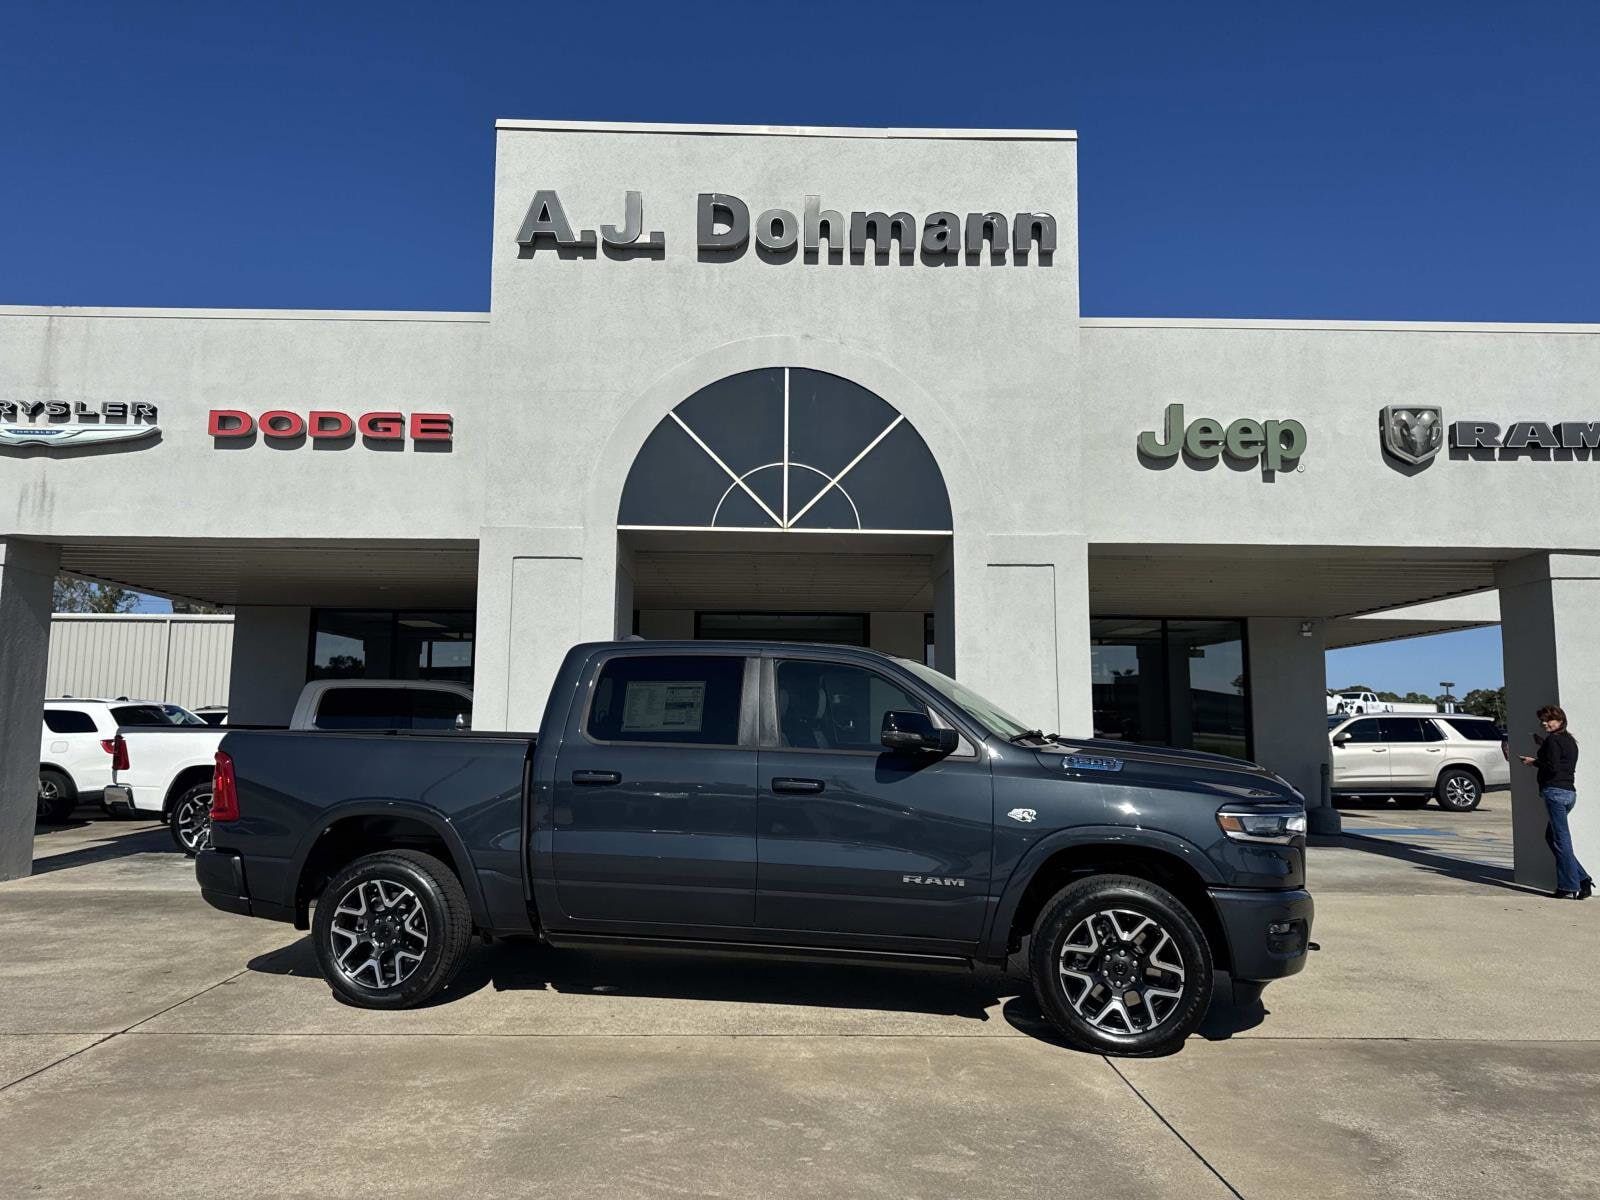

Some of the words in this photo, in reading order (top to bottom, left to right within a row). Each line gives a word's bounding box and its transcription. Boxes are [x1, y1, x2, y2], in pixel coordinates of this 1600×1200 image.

[515, 190, 665, 255] A.J.
[697, 193, 1057, 258] Dohmann
[208, 410, 453, 443] DODGE
[1138, 403, 1307, 472] Jeep
[1452, 421, 1600, 449] RAM
[903, 875, 965, 887] RAM
